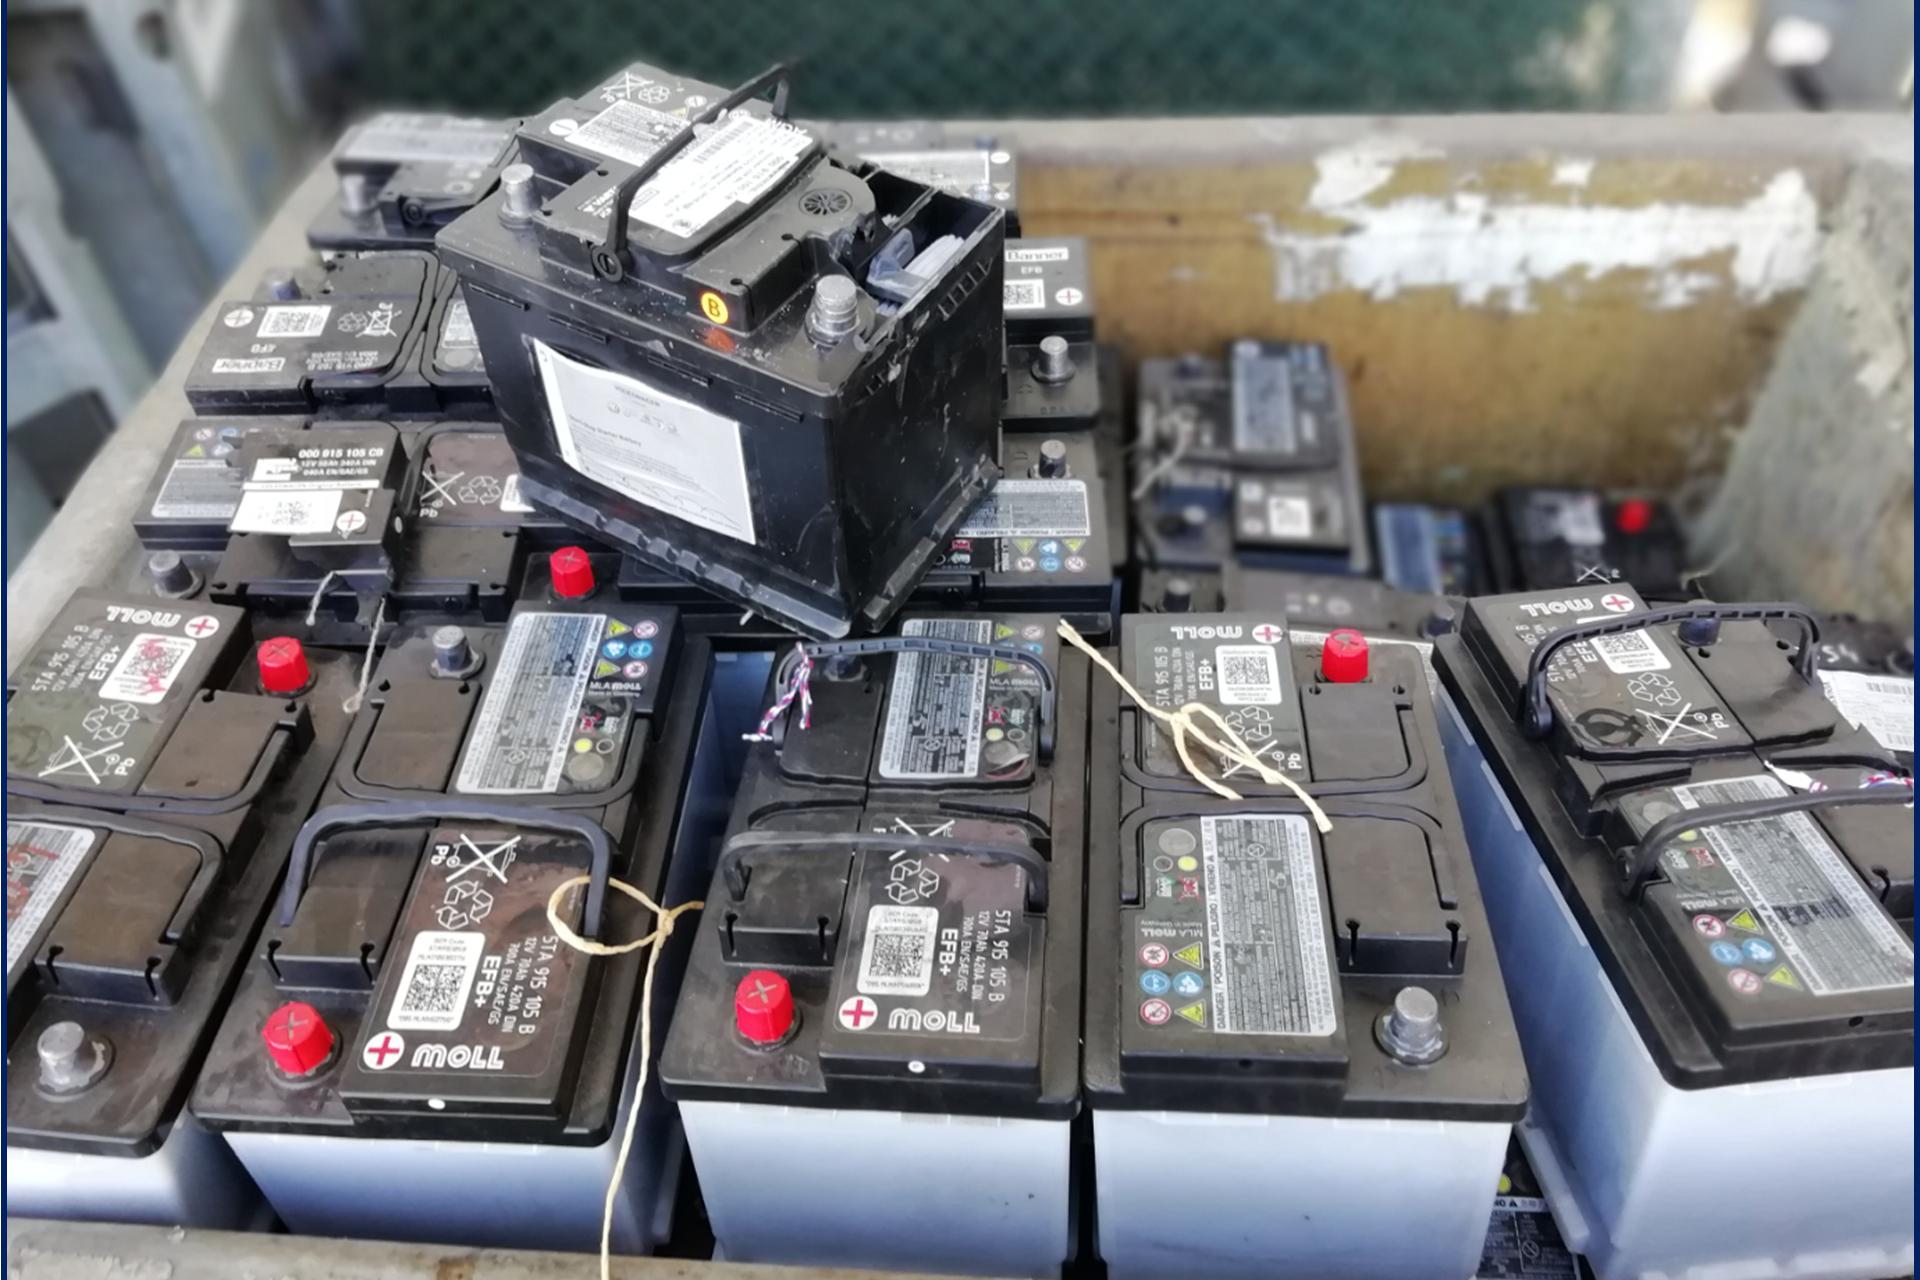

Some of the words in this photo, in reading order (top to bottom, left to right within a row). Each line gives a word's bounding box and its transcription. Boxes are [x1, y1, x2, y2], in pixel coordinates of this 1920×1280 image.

[707, 297, 720, 317] B
[347, 448, 365, 458] 105
[419, 509, 438, 518] Pb
[88, 644, 121, 681] EFB+
[1199, 658, 1214, 691] EFB+
[1711, 712, 1729, 729] Pb
[114, 758, 136, 776] Pb
[1288, 753, 1303, 769] Pb
[431, 845, 450, 865] Pb
[962, 916, 974, 940] 700A
[978, 910, 990, 927] 12V
[975, 929, 989, 953] 70Ah
[1178, 928, 1203, 938] MLA
[507, 942, 522, 965] 700A
[524, 936, 537, 955] 12V
[939, 928, 959, 977] EFB+
[991, 940, 1009, 960] 915
[515, 957, 534, 982] 70Ah
[956, 940, 972, 993] EN/SAE/GS
[973, 955, 986, 983] 420A
[474, 955, 502, 1008] EFB+
[529, 967, 551, 990] 915
[989, 967, 1007, 988] 105
[488, 967, 513, 1025] EN/SAE/GS
[506, 984, 524, 1013] 420A
[988, 993, 1005, 1002] B
[524, 995, 543, 1019] 105
[501, 1015, 517, 1033] DIN
[518, 1024, 536, 1035] B
